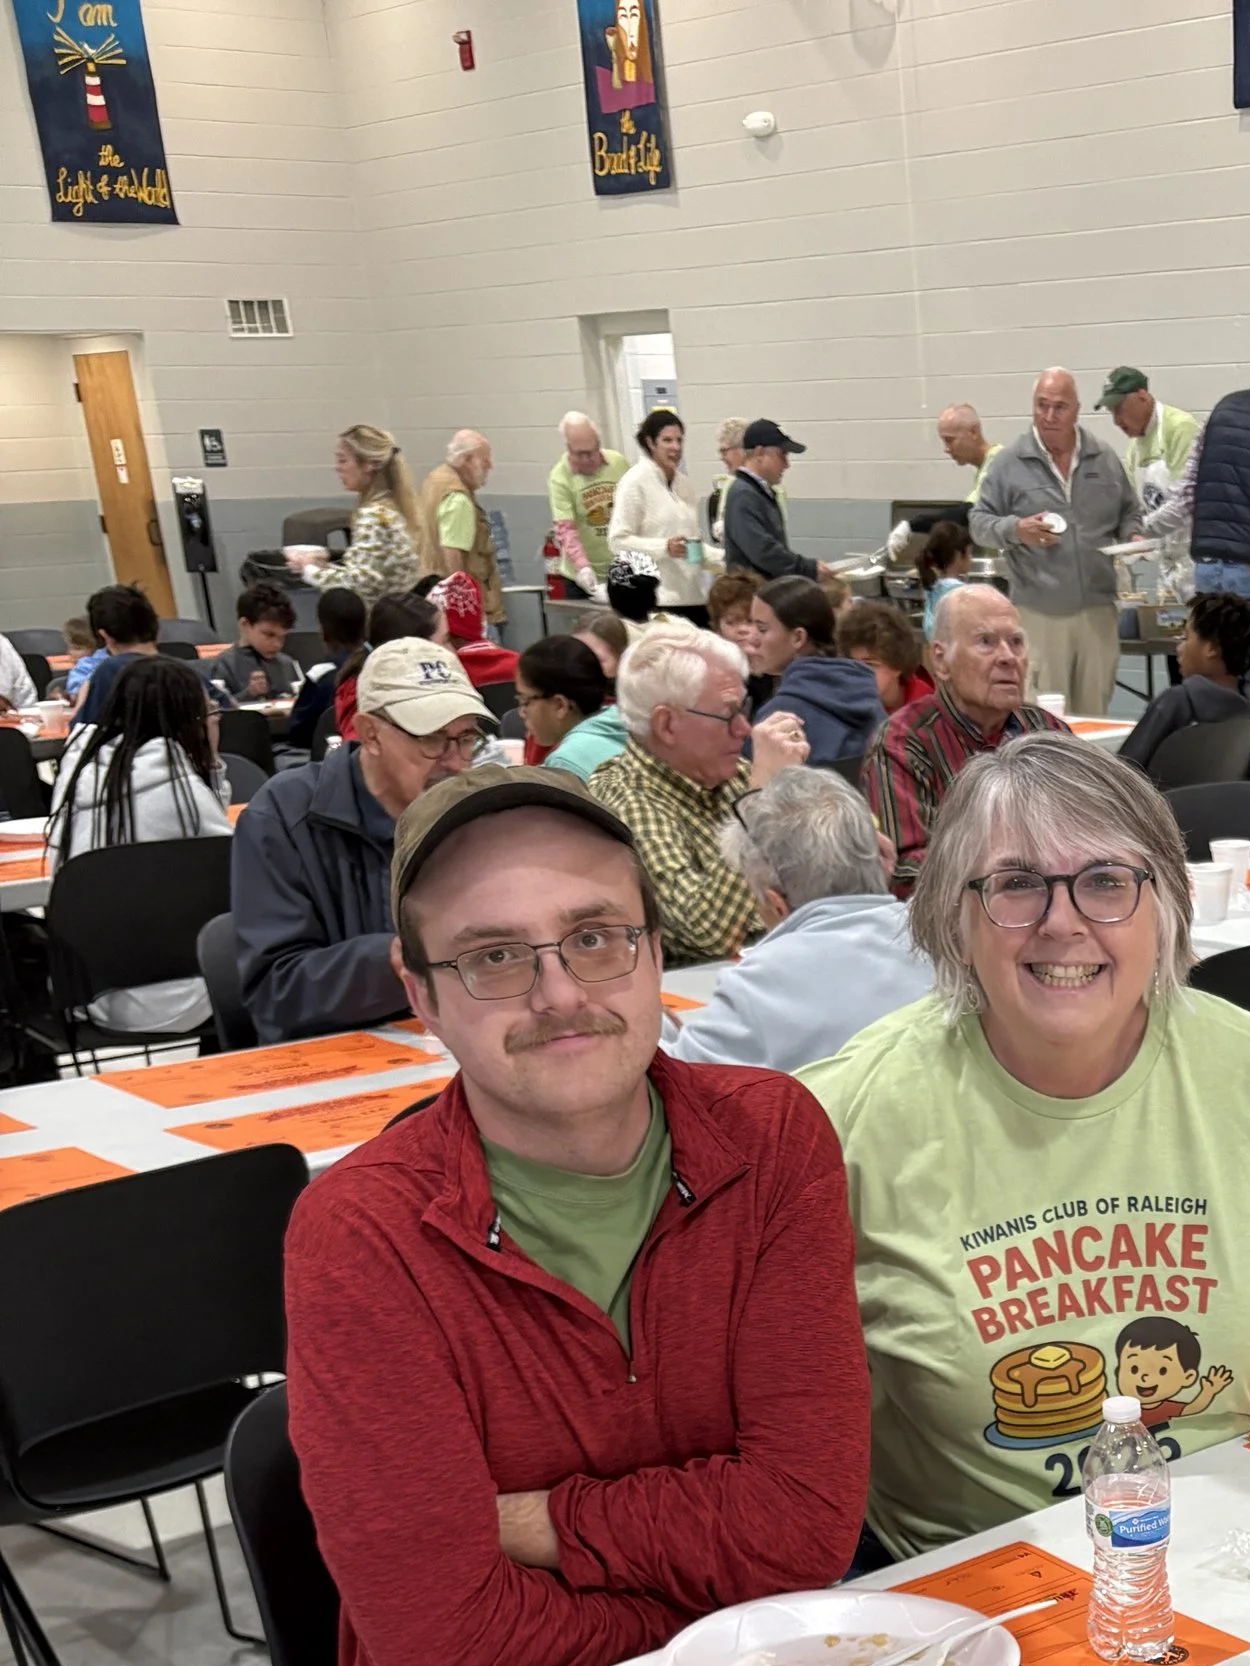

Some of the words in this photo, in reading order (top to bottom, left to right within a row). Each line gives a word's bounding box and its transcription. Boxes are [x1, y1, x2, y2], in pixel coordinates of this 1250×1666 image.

[78, 4, 117, 26] am
[620, 110, 636, 134] the
[98, 144, 124, 167] the
[56, 168, 98, 216] Light
[97, 174, 112, 199] of
[114, 173, 135, 198] the
[131, 168, 171, 208] World
[959, 1216, 1037, 1252] KIWANIS
[1042, 1201, 1088, 1223] CLUB
[1095, 1199, 1120, 1214] OF
[1127, 1197, 1208, 1215] RALEIGH
[967, 1223, 1209, 1299] PANCAKE
[971, 1275, 1217, 1345] BREAKFAST
[1120, 1521, 1156, 1533] Purified
